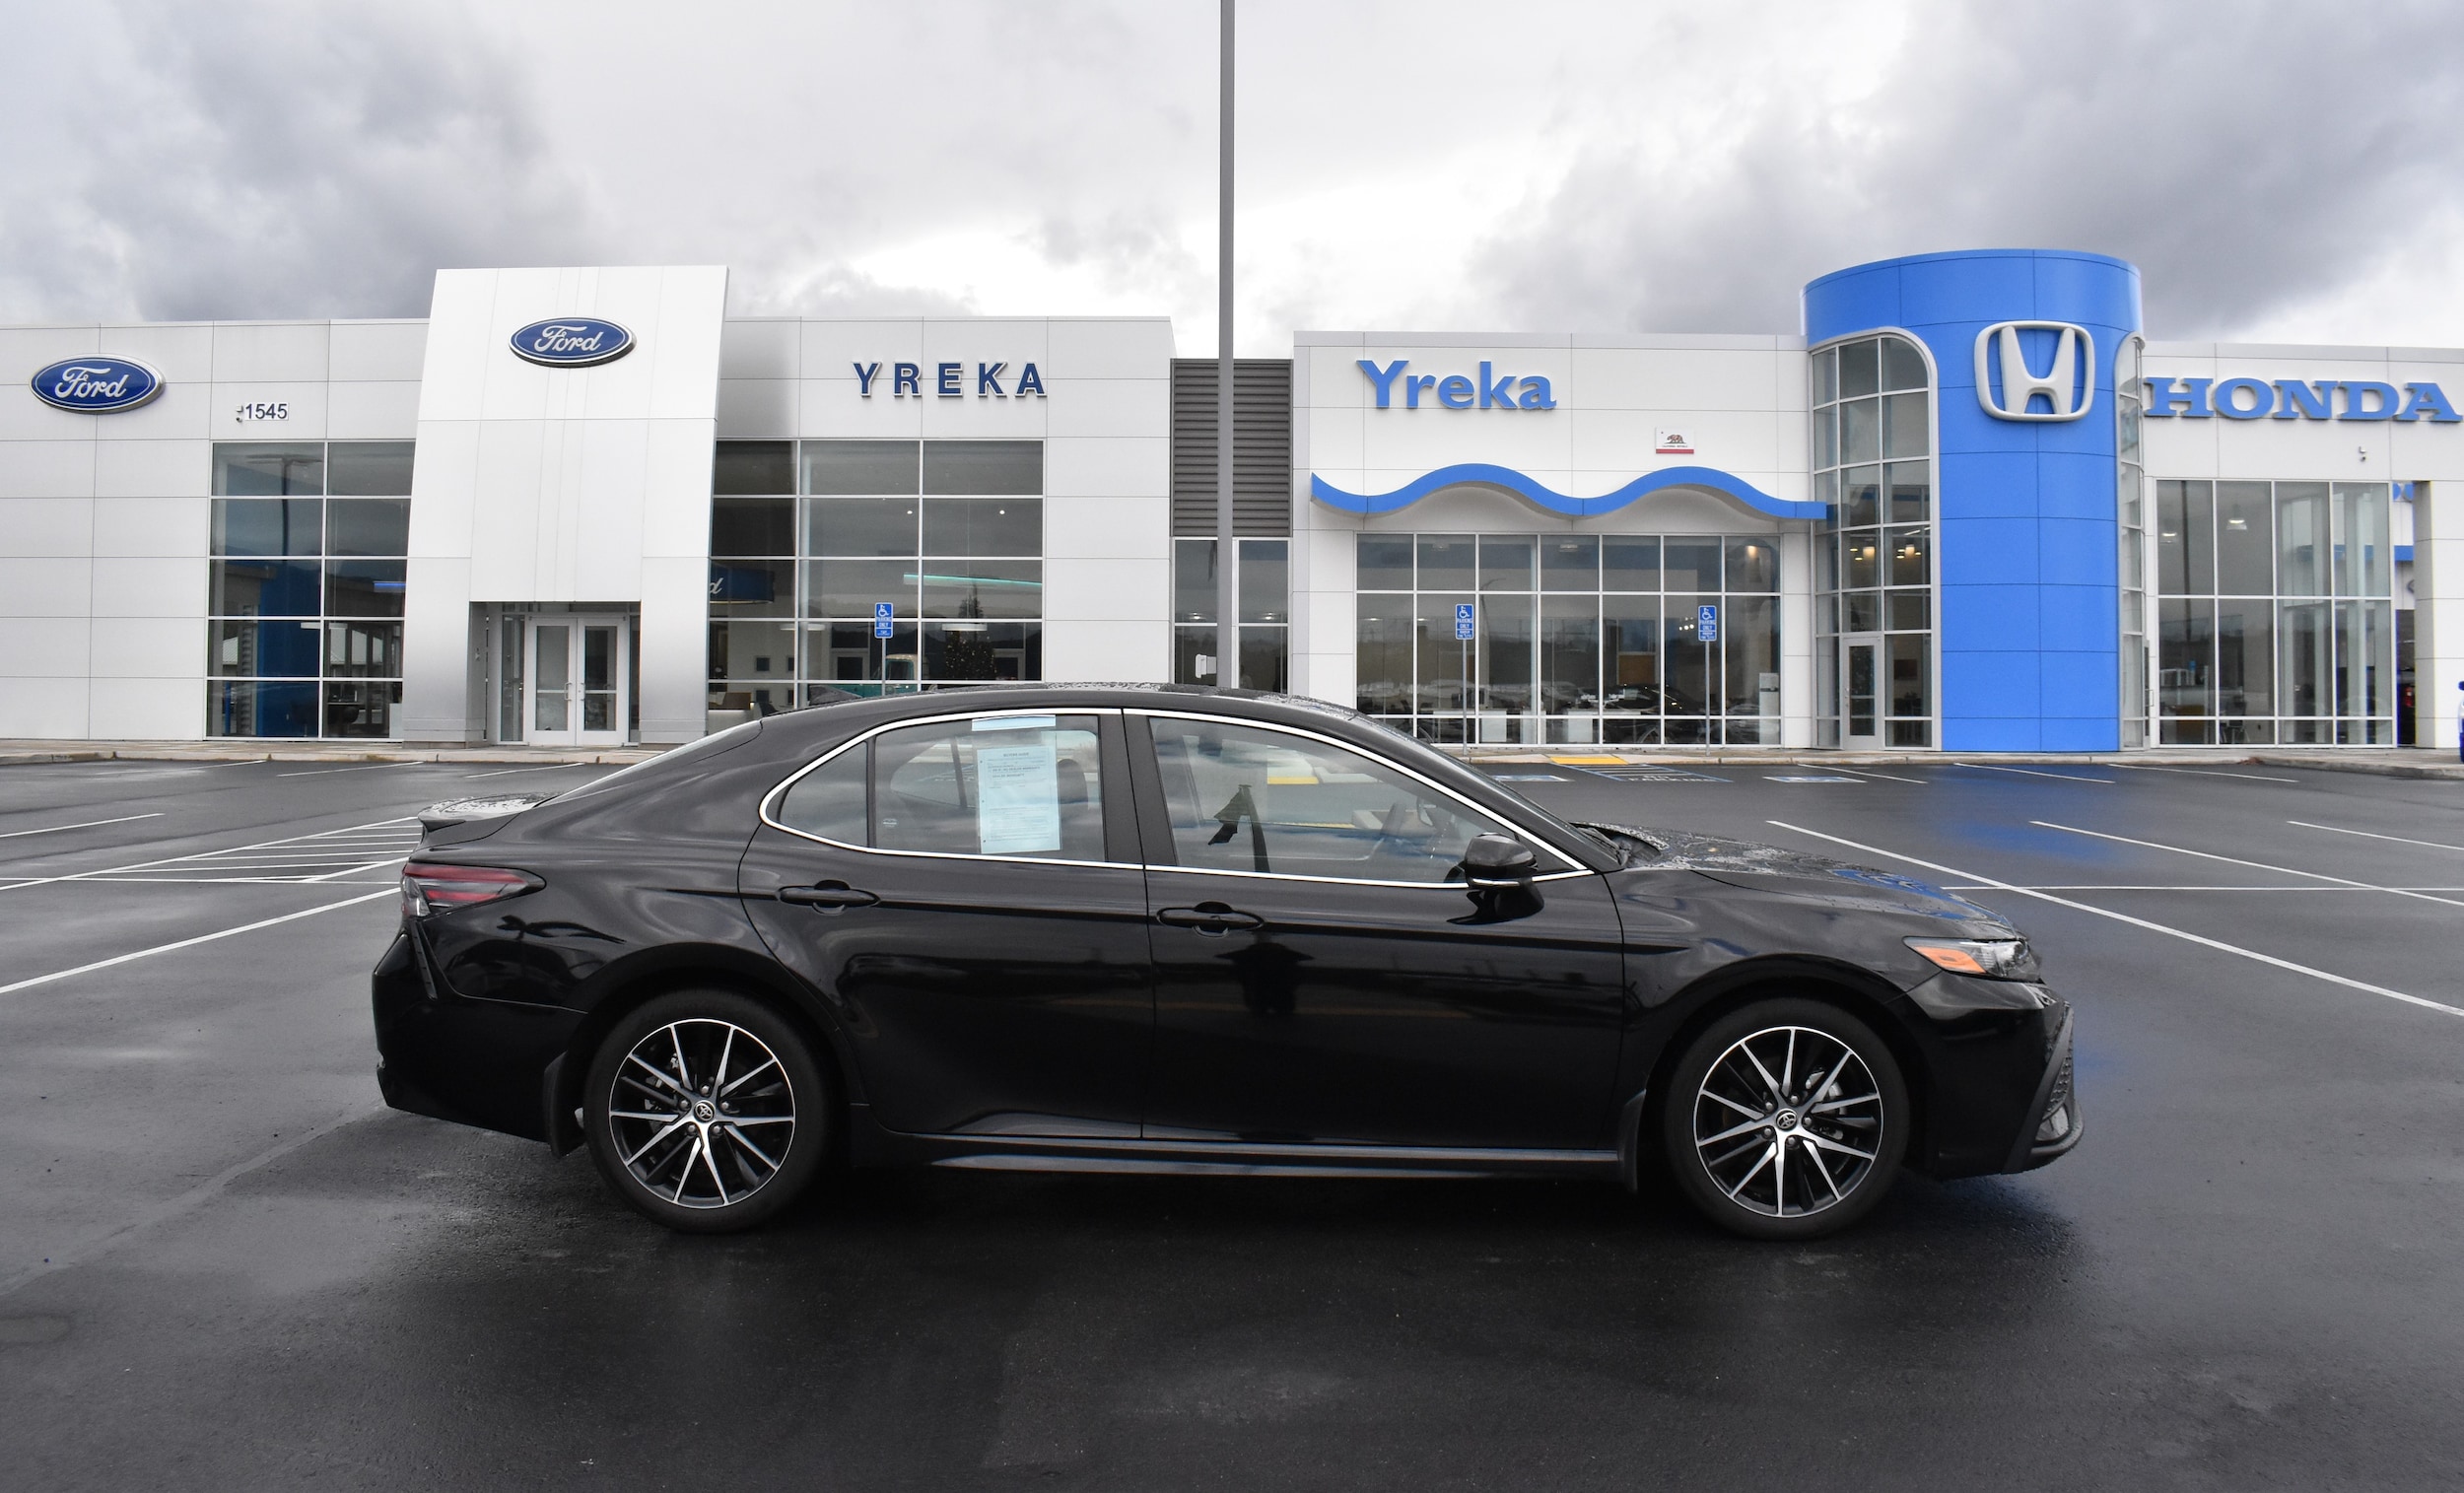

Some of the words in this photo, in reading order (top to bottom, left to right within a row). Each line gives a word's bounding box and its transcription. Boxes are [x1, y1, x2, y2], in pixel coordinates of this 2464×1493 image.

[534, 325, 604, 352] Ford
[54, 366, 130, 398] Ford
[853, 362, 1048, 398] YREKA
[1355, 359, 1557, 410] Yreka
[244, 403, 288, 420] 1545
[2143, 376, 2463, 422] HONDA
